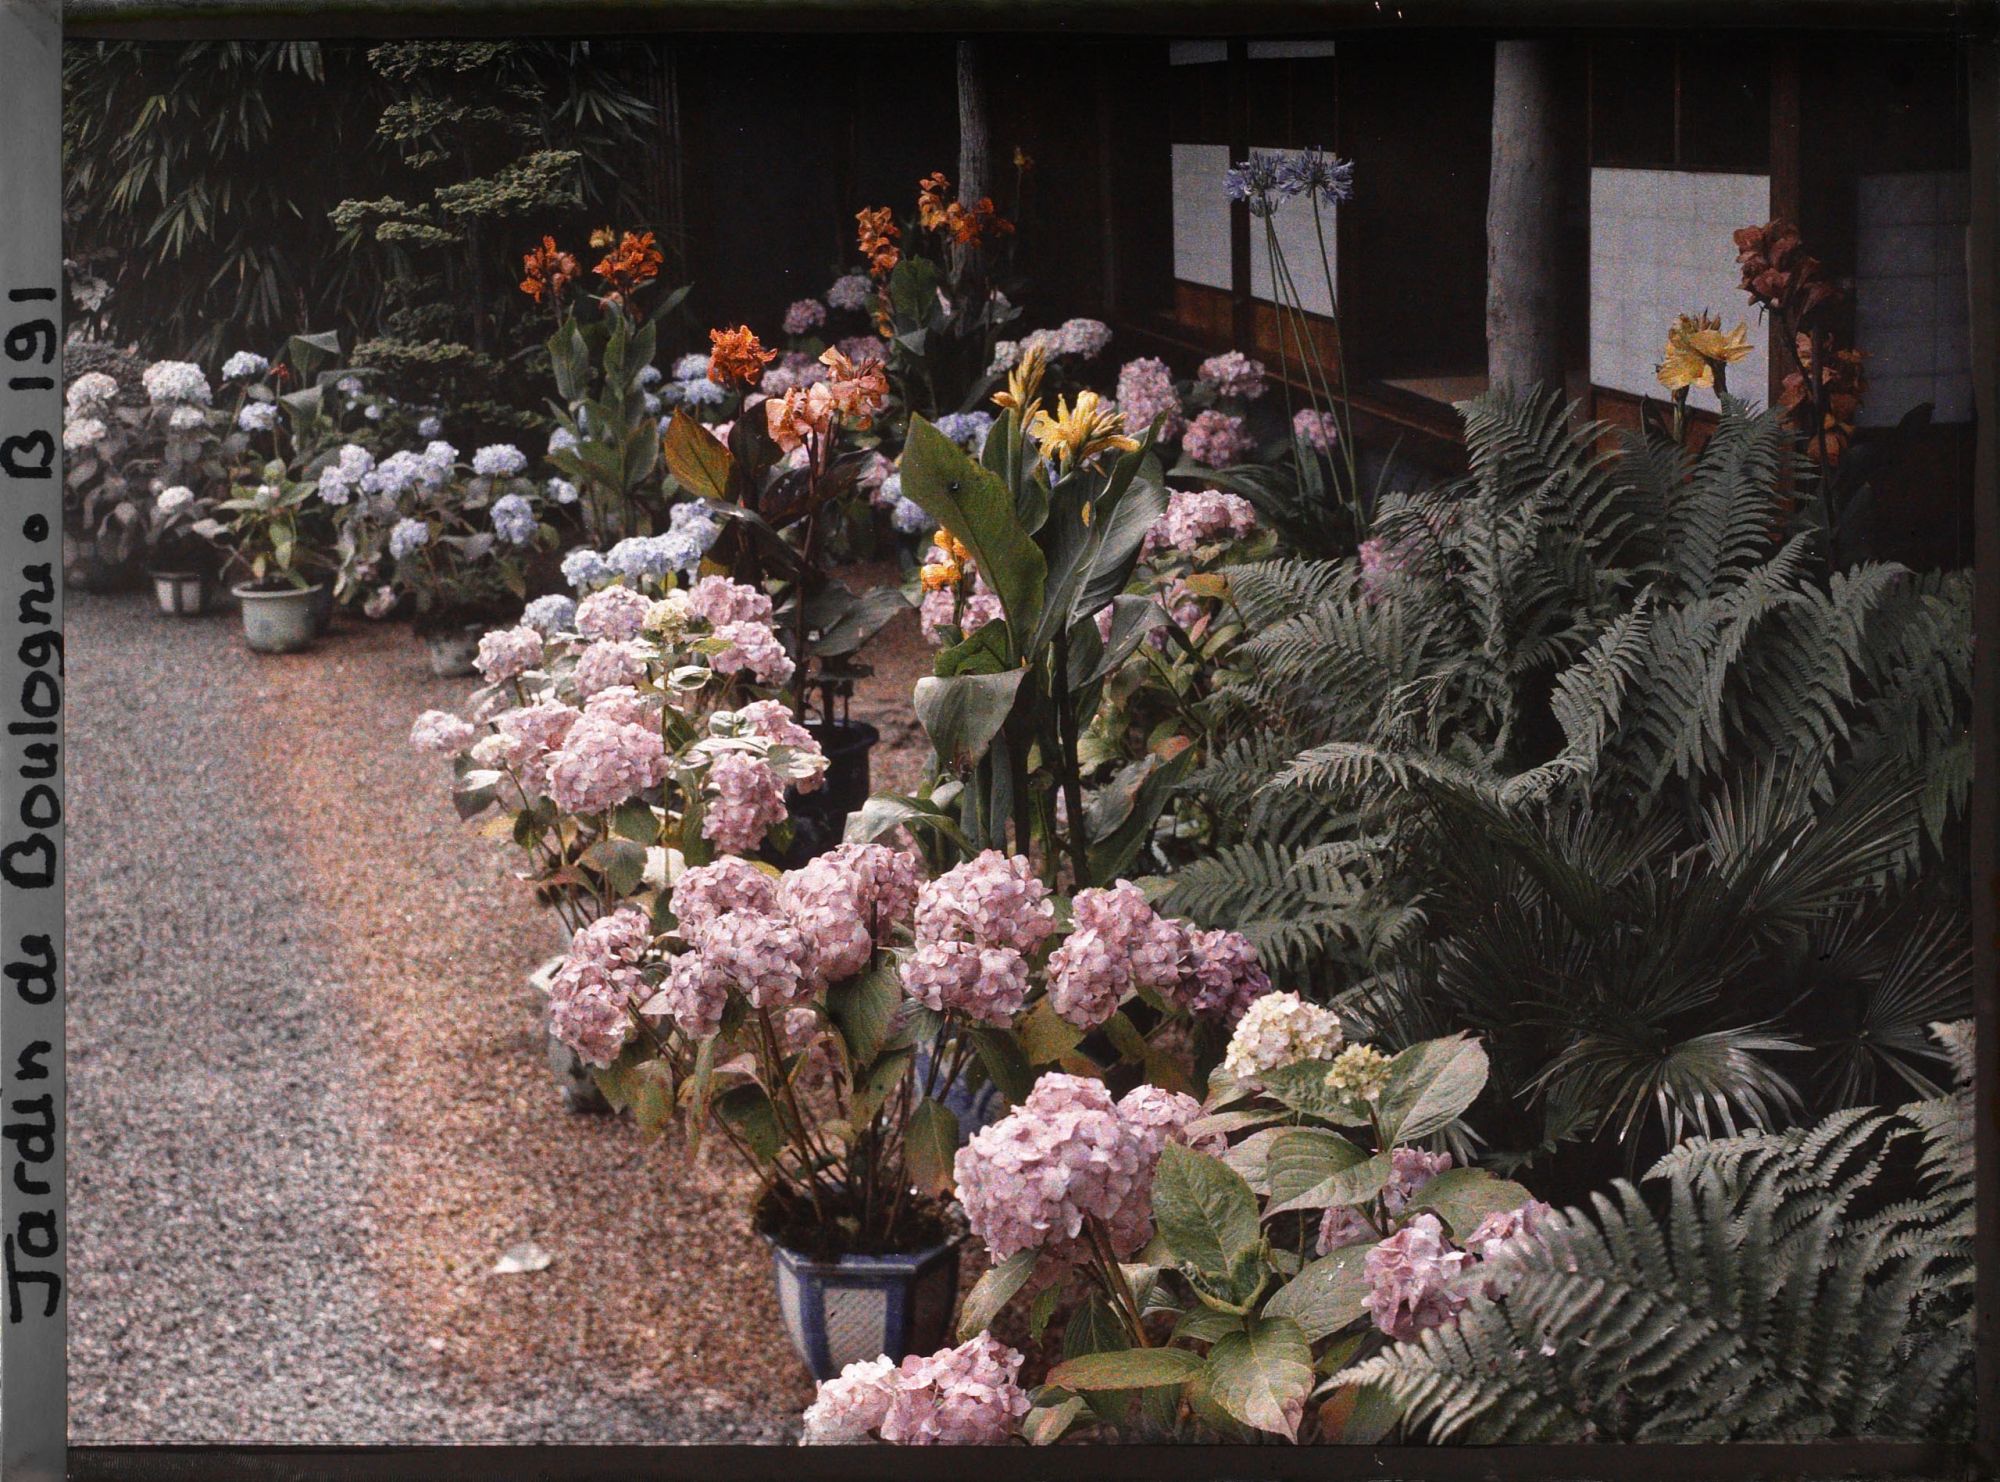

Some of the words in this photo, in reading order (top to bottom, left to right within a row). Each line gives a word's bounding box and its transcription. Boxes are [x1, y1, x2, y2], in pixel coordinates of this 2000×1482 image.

[4, 287, 57, 390] 191
[0, 562, 65, 889] Boulogne
[3, 934, 57, 1004] de
[0, 1041, 60, 1324] Jardin
